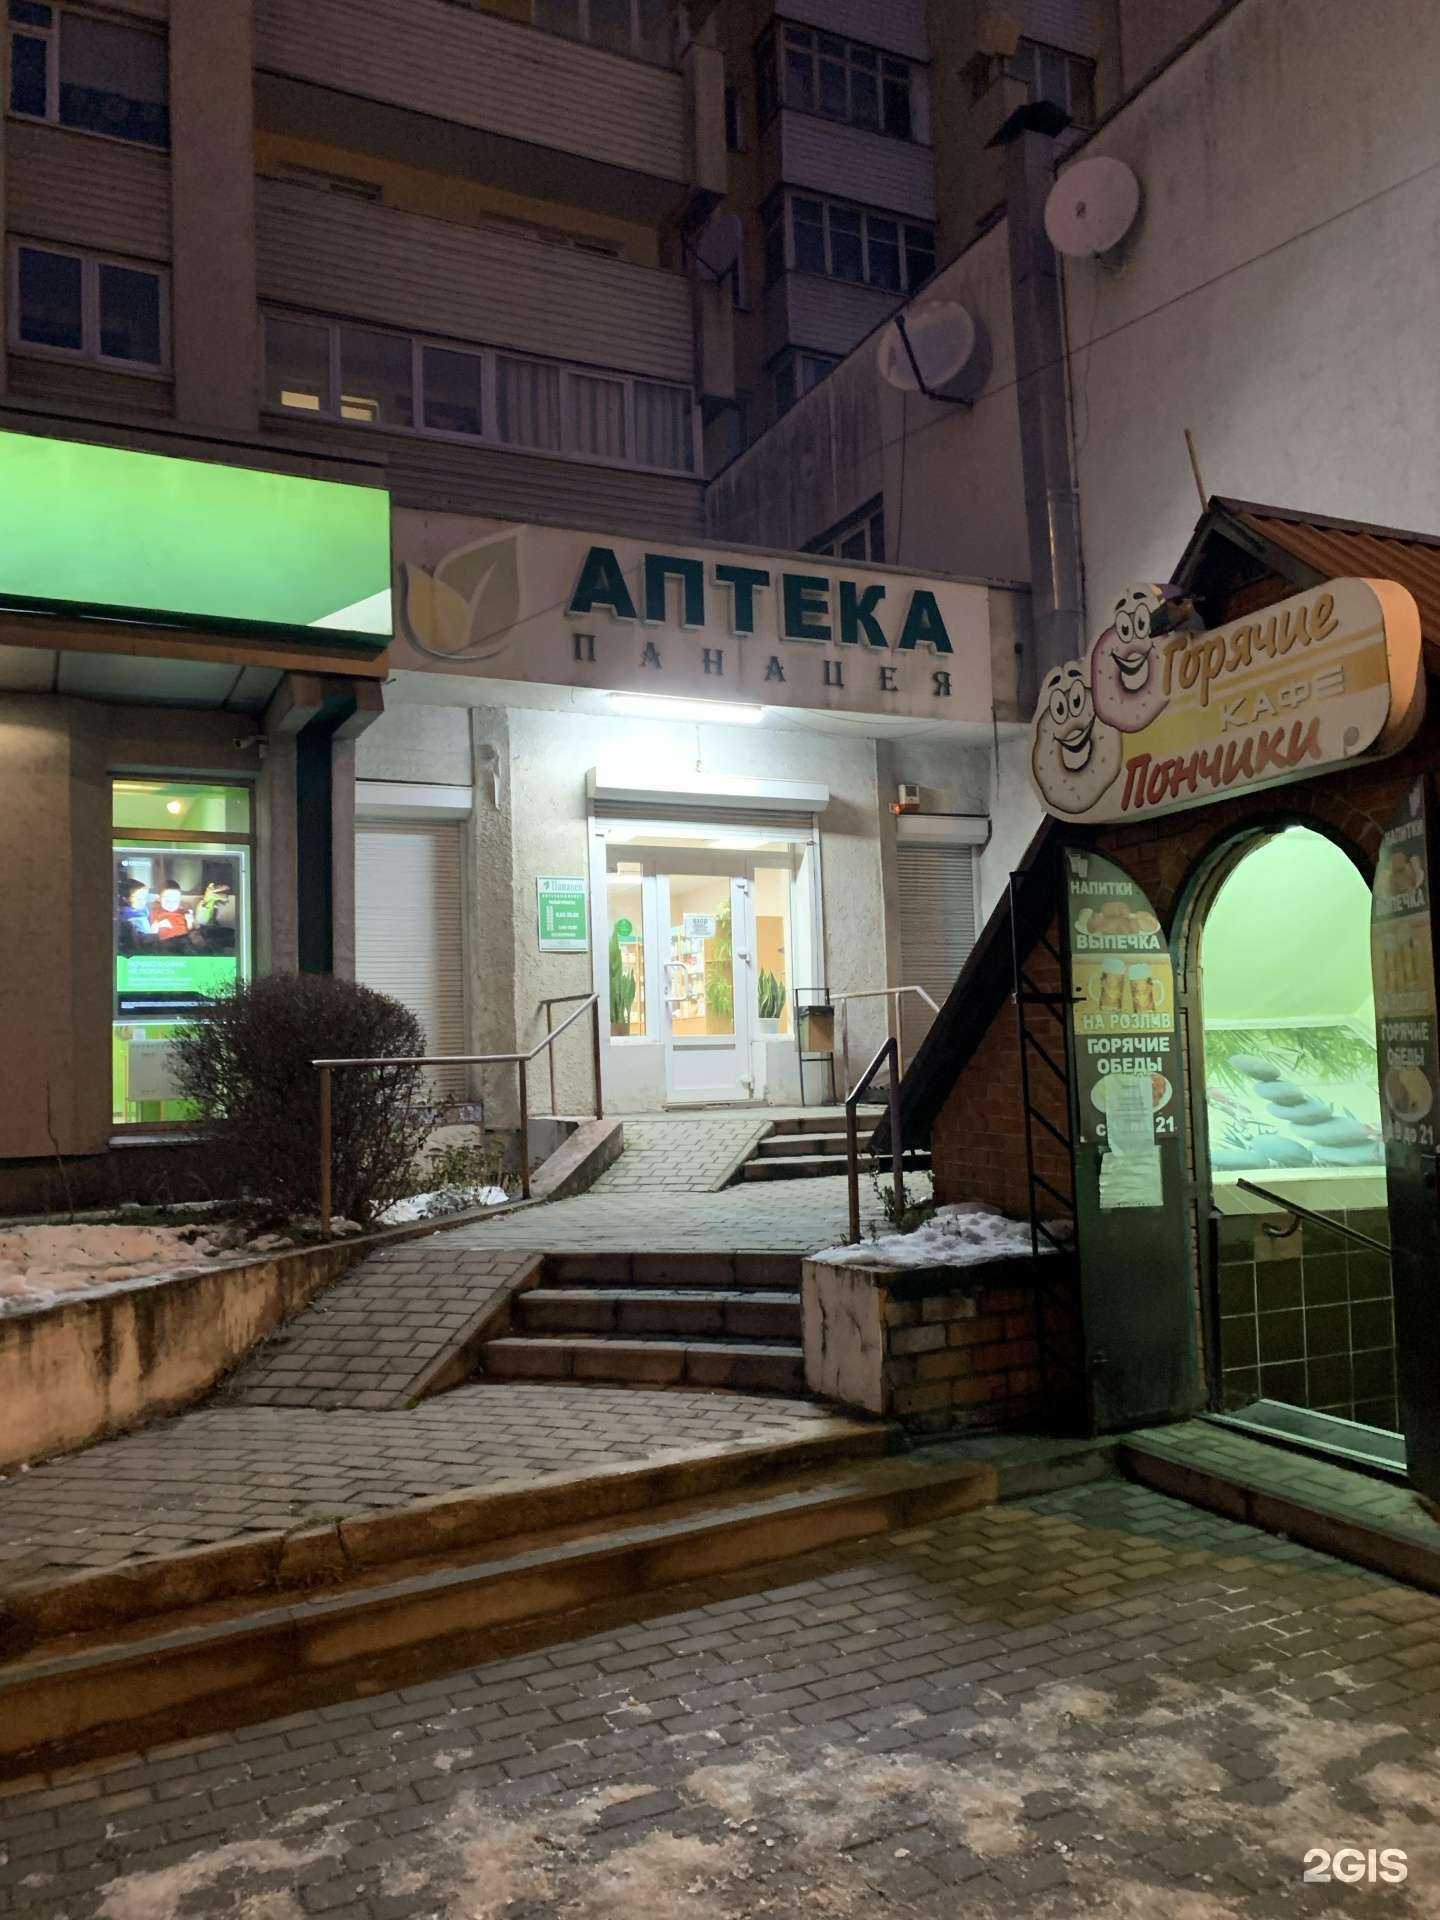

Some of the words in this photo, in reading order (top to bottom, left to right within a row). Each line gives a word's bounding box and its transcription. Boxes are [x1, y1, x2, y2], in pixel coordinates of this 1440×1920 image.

[567, 546, 954, 656] АПТЕКА
[1161, 593, 1339, 707] Горячие
[572, 632, 952, 697] ПАНАЦЕЯ
[1220, 664, 1345, 733] КАФЕ
[1119, 716, 1322, 811] Пончики
[1070, 880, 1133, 896] НАПИТКИ
[1076, 935, 1161, 950] ВЫПЕЧКА
[1083, 1014, 1105, 1030] НА
[1110, 1013, 1171, 1029] РОЗЛИВ
[1381, 1022, 1430, 1042] ГОРЯЧИЕ
[1087, 1037, 1170, 1054] ГОРЯЧИЕ
[1096, 1056, 1163, 1075] ОБЕДЫ
[1155, 1115, 1175, 1133] 21
[1418, 1123, 1435, 1146] 21
